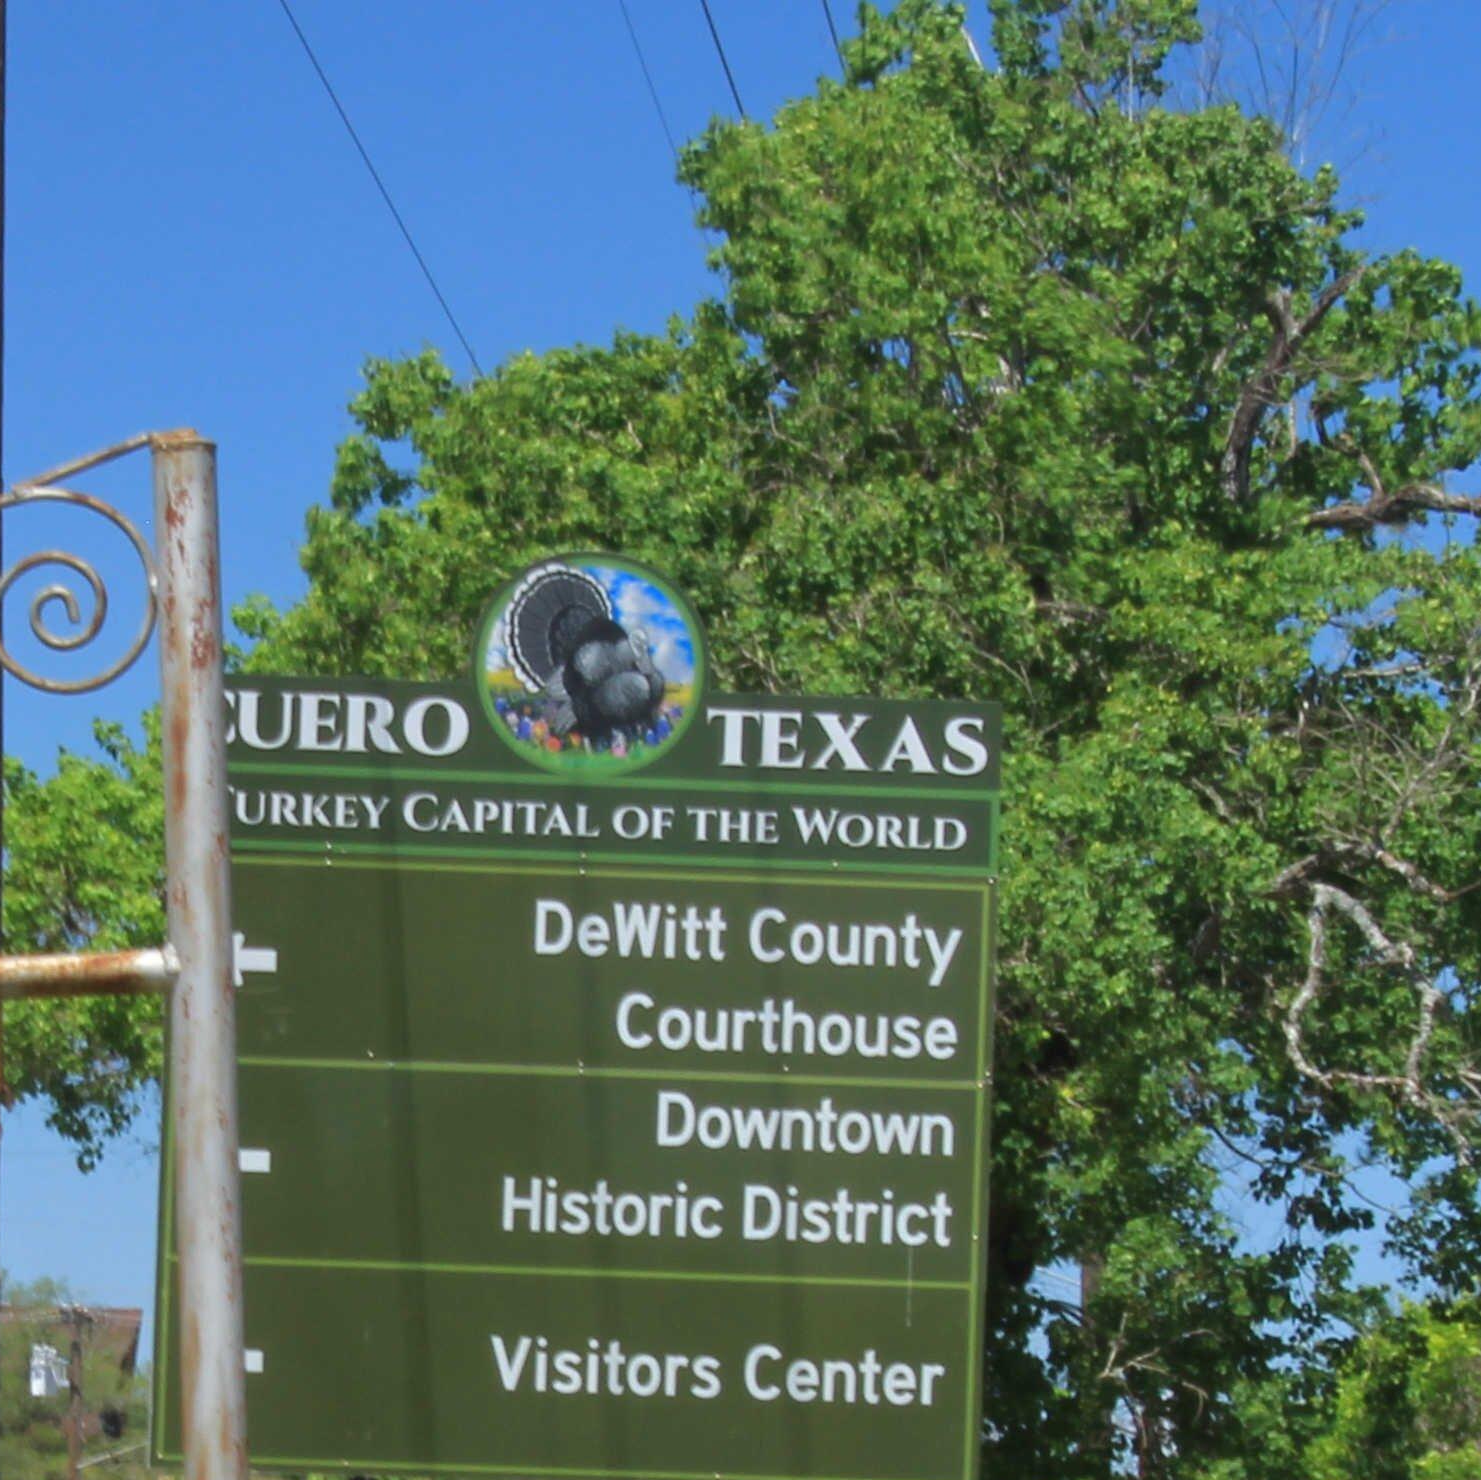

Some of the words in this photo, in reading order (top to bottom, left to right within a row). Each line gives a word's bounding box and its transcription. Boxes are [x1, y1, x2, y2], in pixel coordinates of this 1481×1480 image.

[223, 689, 470, 756] UERO
[706, 706, 988, 777] TEXAS
[228, 786, 390, 829] URKEY
[402, 792, 600, 837] CAPITAL
[612, 805, 675, 840] OF
[686, 807, 779, 844] THE
[792, 807, 968, 851] WORLD
[534, 899, 727, 960] DeWitt
[748, 907, 963, 987] County
[615, 991, 958, 1060] Courthouse
[656, 1090, 955, 1157] Downtown
[502, 1176, 724, 1238] Historic
[742, 1184, 953, 1248] District
[491, 1335, 721, 1398] Visitors
[744, 1343, 945, 1406] Center
